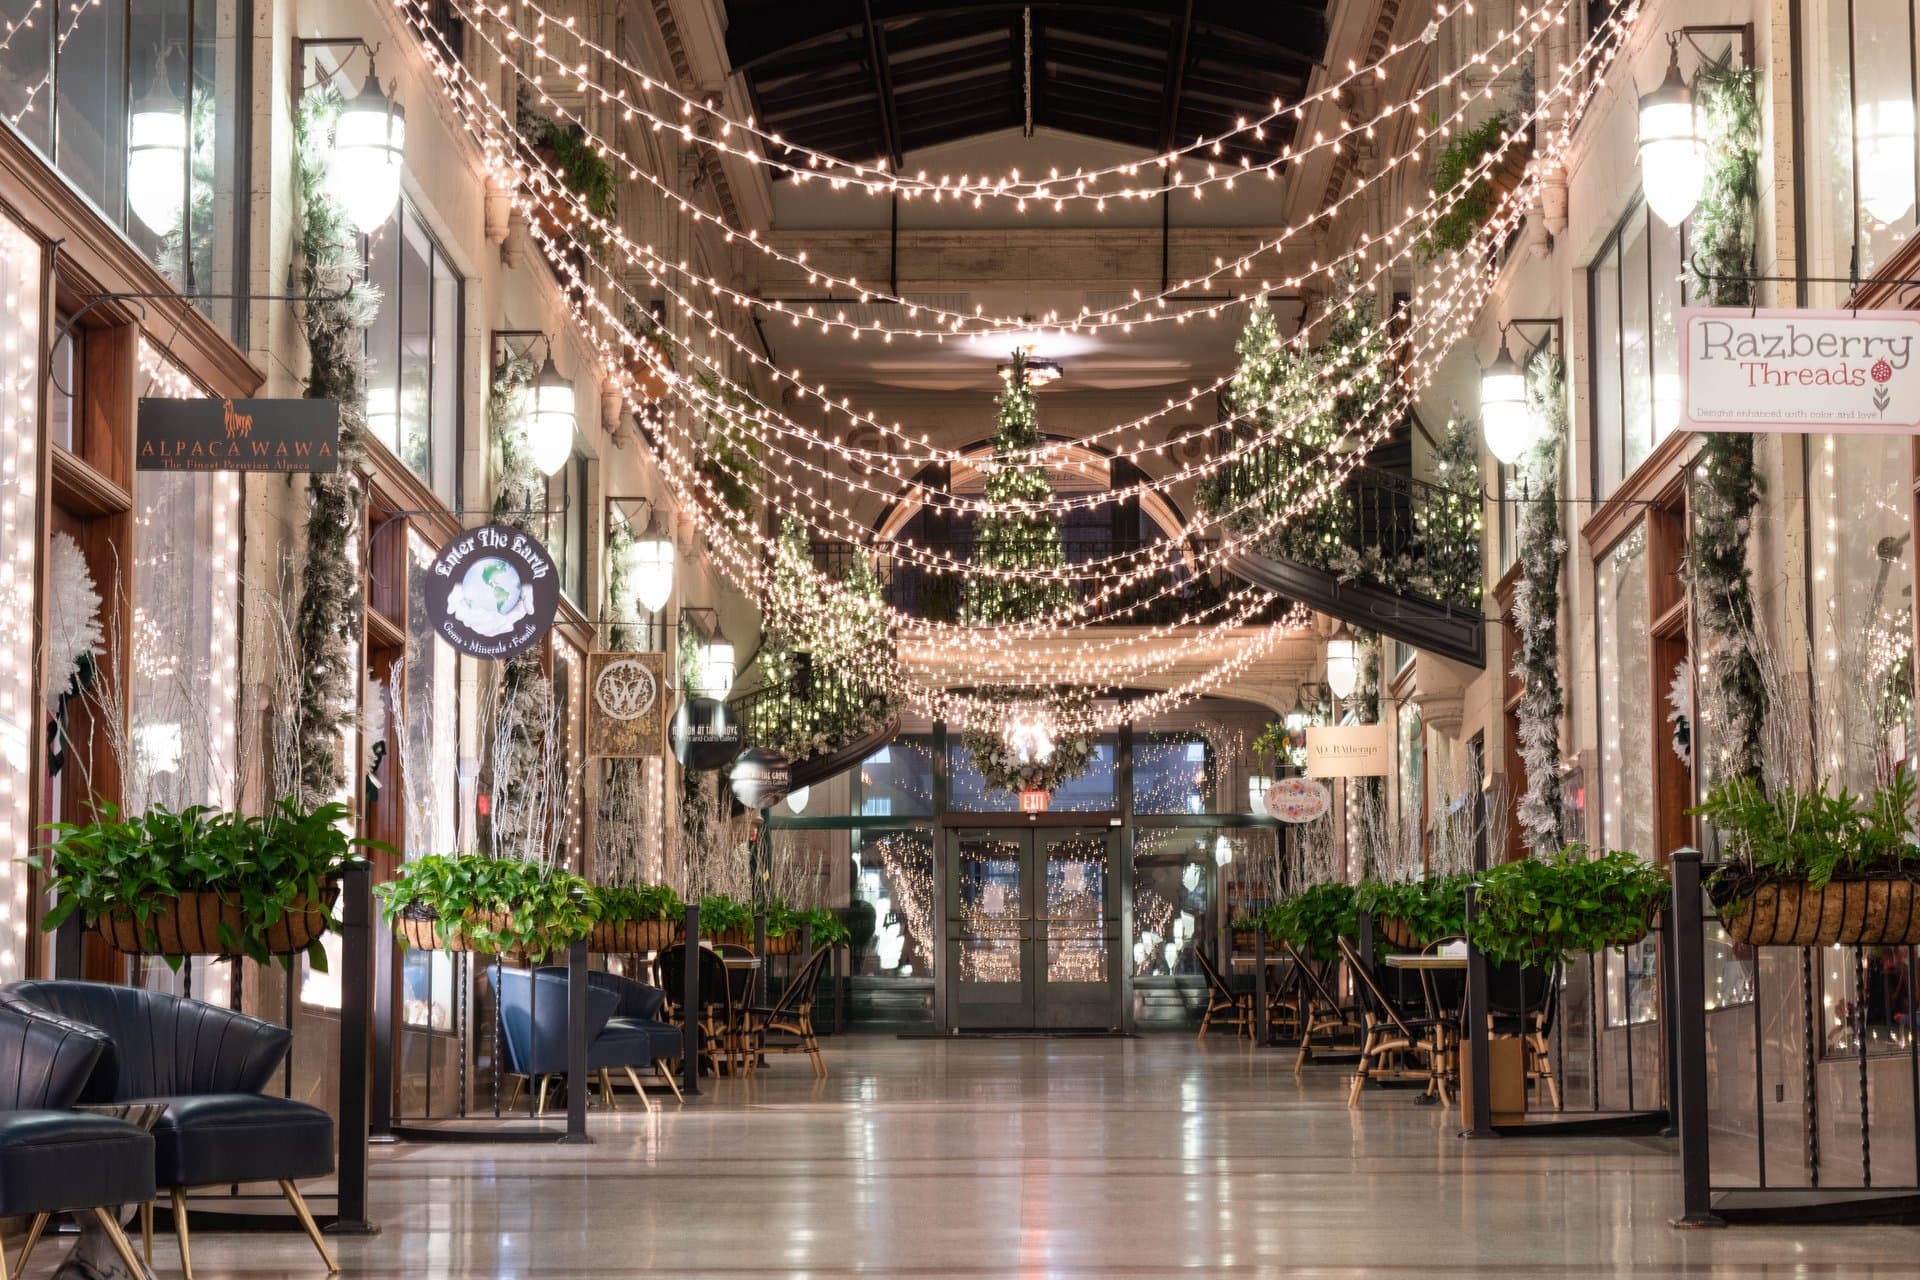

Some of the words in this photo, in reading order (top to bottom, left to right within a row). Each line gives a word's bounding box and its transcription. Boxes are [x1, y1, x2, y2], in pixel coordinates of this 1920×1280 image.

[1698, 320, 1913, 370] Razberry
[1740, 362, 1867, 387] Threads
[1697, 407, 1733, 418] Designs
[1736, 408, 1783, 418] enhanced
[1784, 408, 1808, 418] with
[1810, 409, 1834, 419] color
[1838, 409, 1856, 419] and
[142, 440, 241, 457] ALPACA
[251, 440, 333, 457] WAWA
[162, 458, 181, 470] The
[187, 459, 219, 470] Finest
[223, 459, 268, 470] Peruvian
[275, 459, 310, 470] Alpaca
[435, 537, 475, 578] Enter
[477, 528, 509, 549] The
[511, 534, 550, 579] Earth
[443, 622, 463, 643] Gems
[468, 640, 507, 655] Minerals
[511, 623, 537, 647] Fossils
[1313, 745, 1378, 755] ADRAtherapy
[1024, 792, 1044, 810] EXIT
